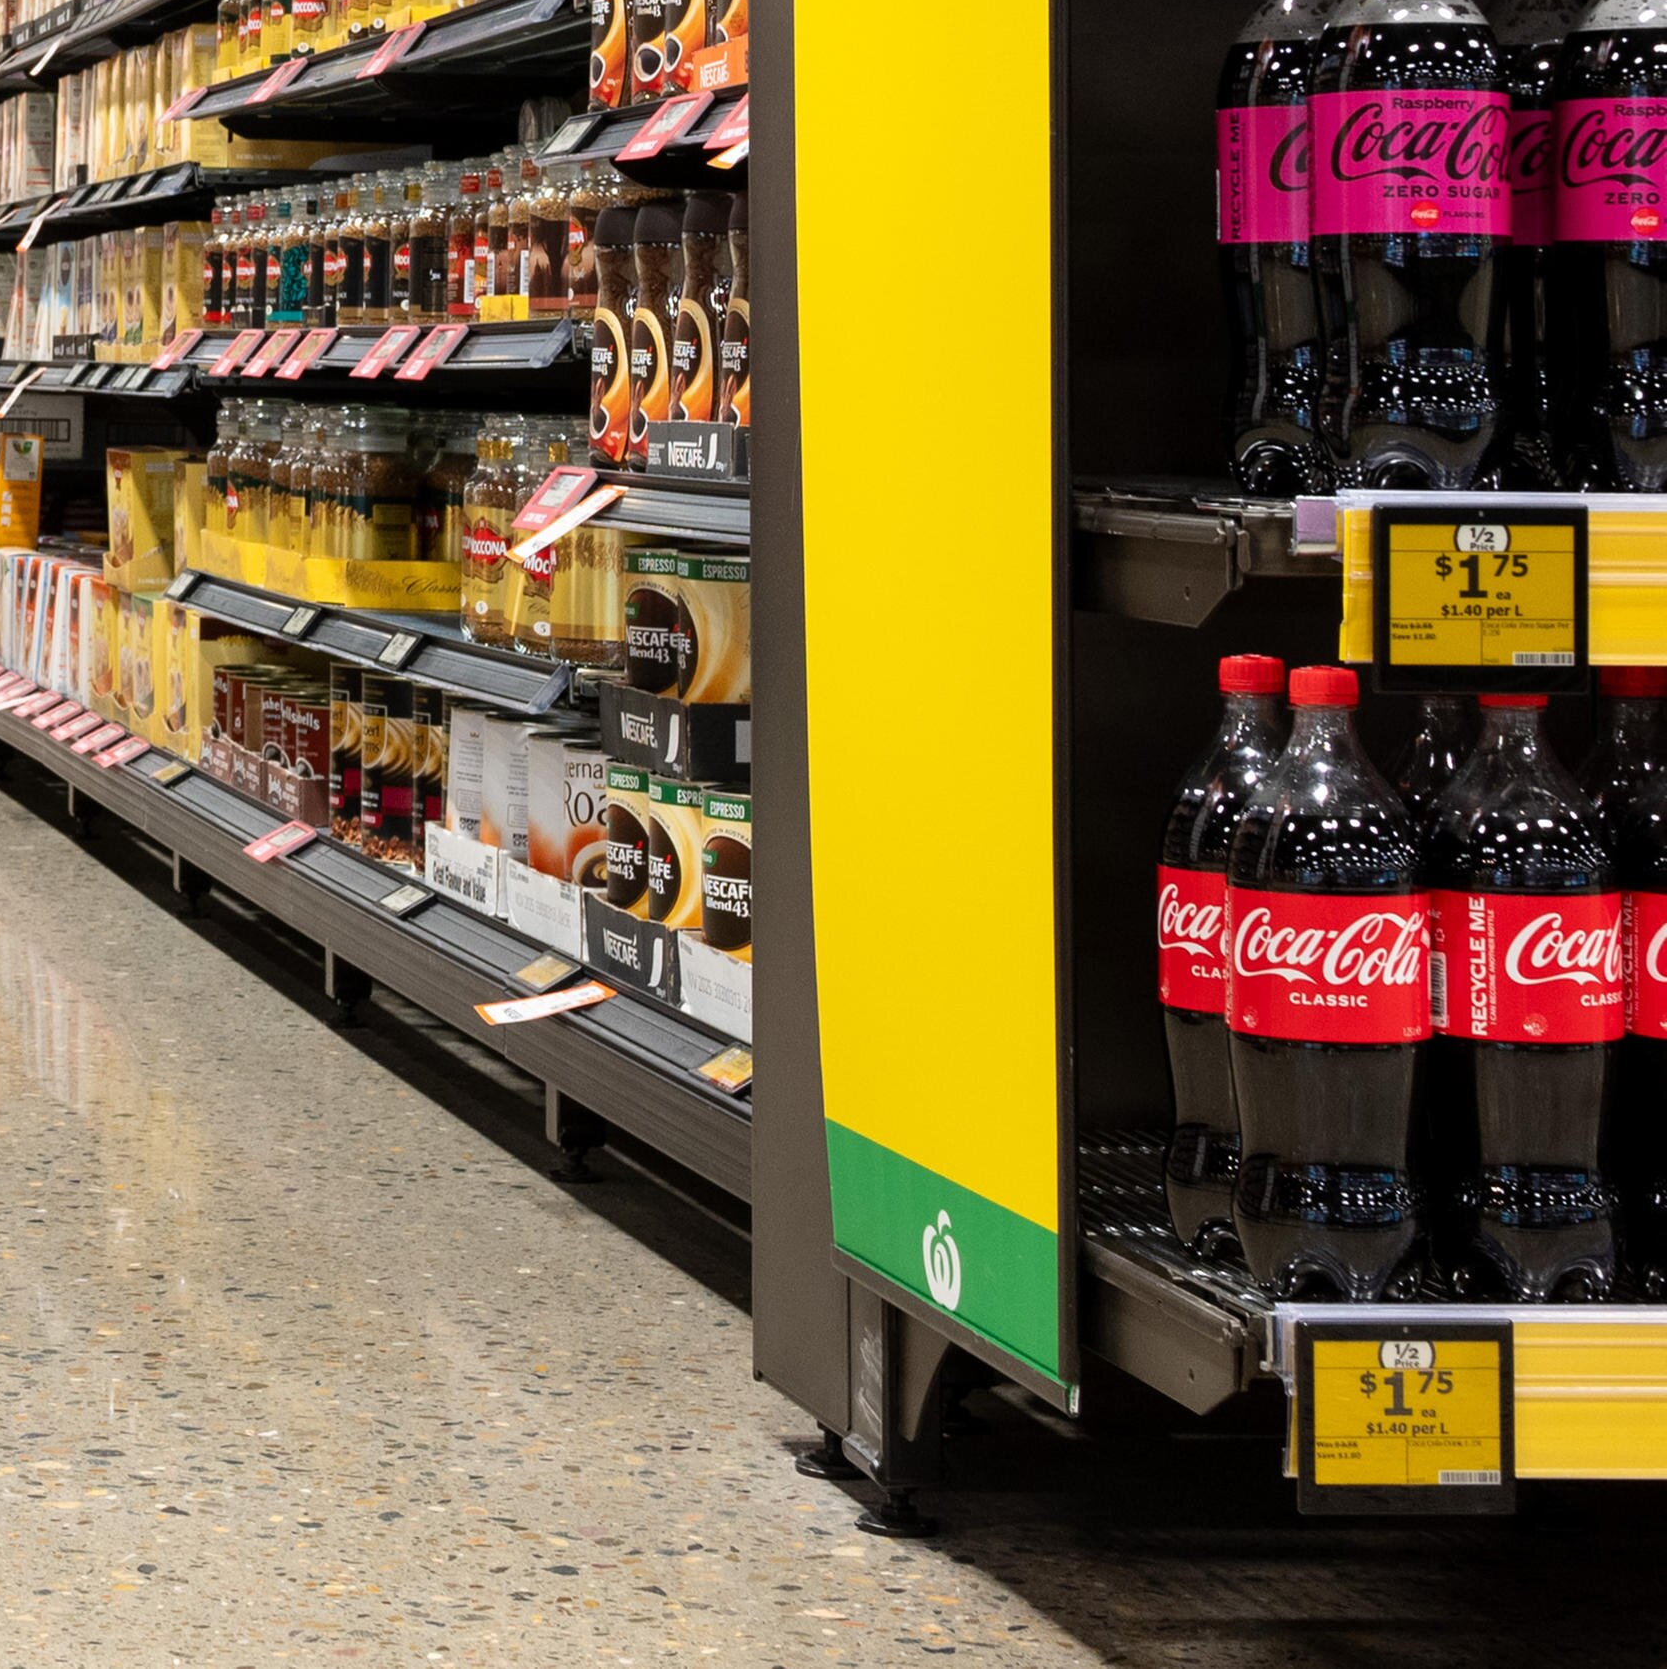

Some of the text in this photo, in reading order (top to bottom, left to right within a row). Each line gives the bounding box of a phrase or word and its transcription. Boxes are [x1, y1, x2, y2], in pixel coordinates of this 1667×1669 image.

[1392, 97, 1476, 113] Raspberry
[1230, 112, 1241, 240] RECYCLE ME
[1383, 185, 1501, 199] ZERO SUGAR
[1469, 542, 1495, 551] Price
[638, 554, 675, 573] ESPRESSO
[702, 564, 747, 581] ESPRESSO
[1441, 604, 1523, 619] $1.40 per L
[1233, 907, 1424, 987] Coca-Cola
[1468, 896, 1488, 1036] RECYCLE ME
[1289, 991, 1368, 1007] CLASSIC
[1366, 1422, 1449, 1438] $1.40 per L
